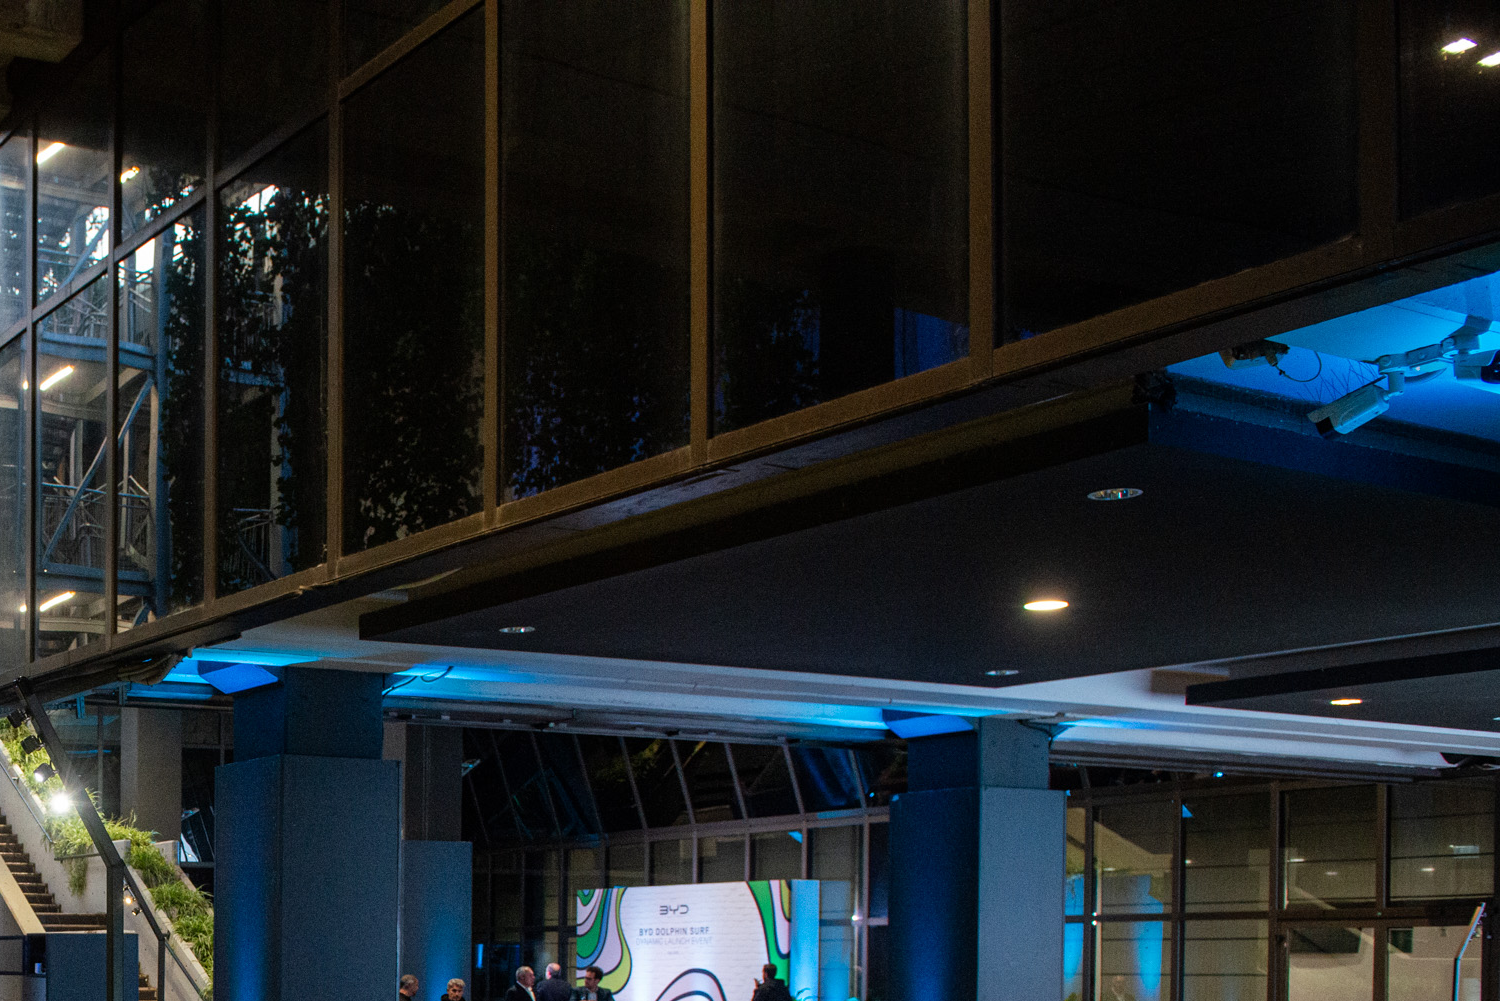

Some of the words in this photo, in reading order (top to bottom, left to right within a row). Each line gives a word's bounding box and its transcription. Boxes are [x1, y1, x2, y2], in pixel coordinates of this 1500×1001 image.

[659, 904, 689, 915] BYD
[639, 928, 653, 936] BYD
[655, 927, 687, 936] DOLPHIN
[690, 926, 710, 935] SURF
[664, 937, 690, 945] LAUNCH
[691, 936, 713, 944] EVENT
